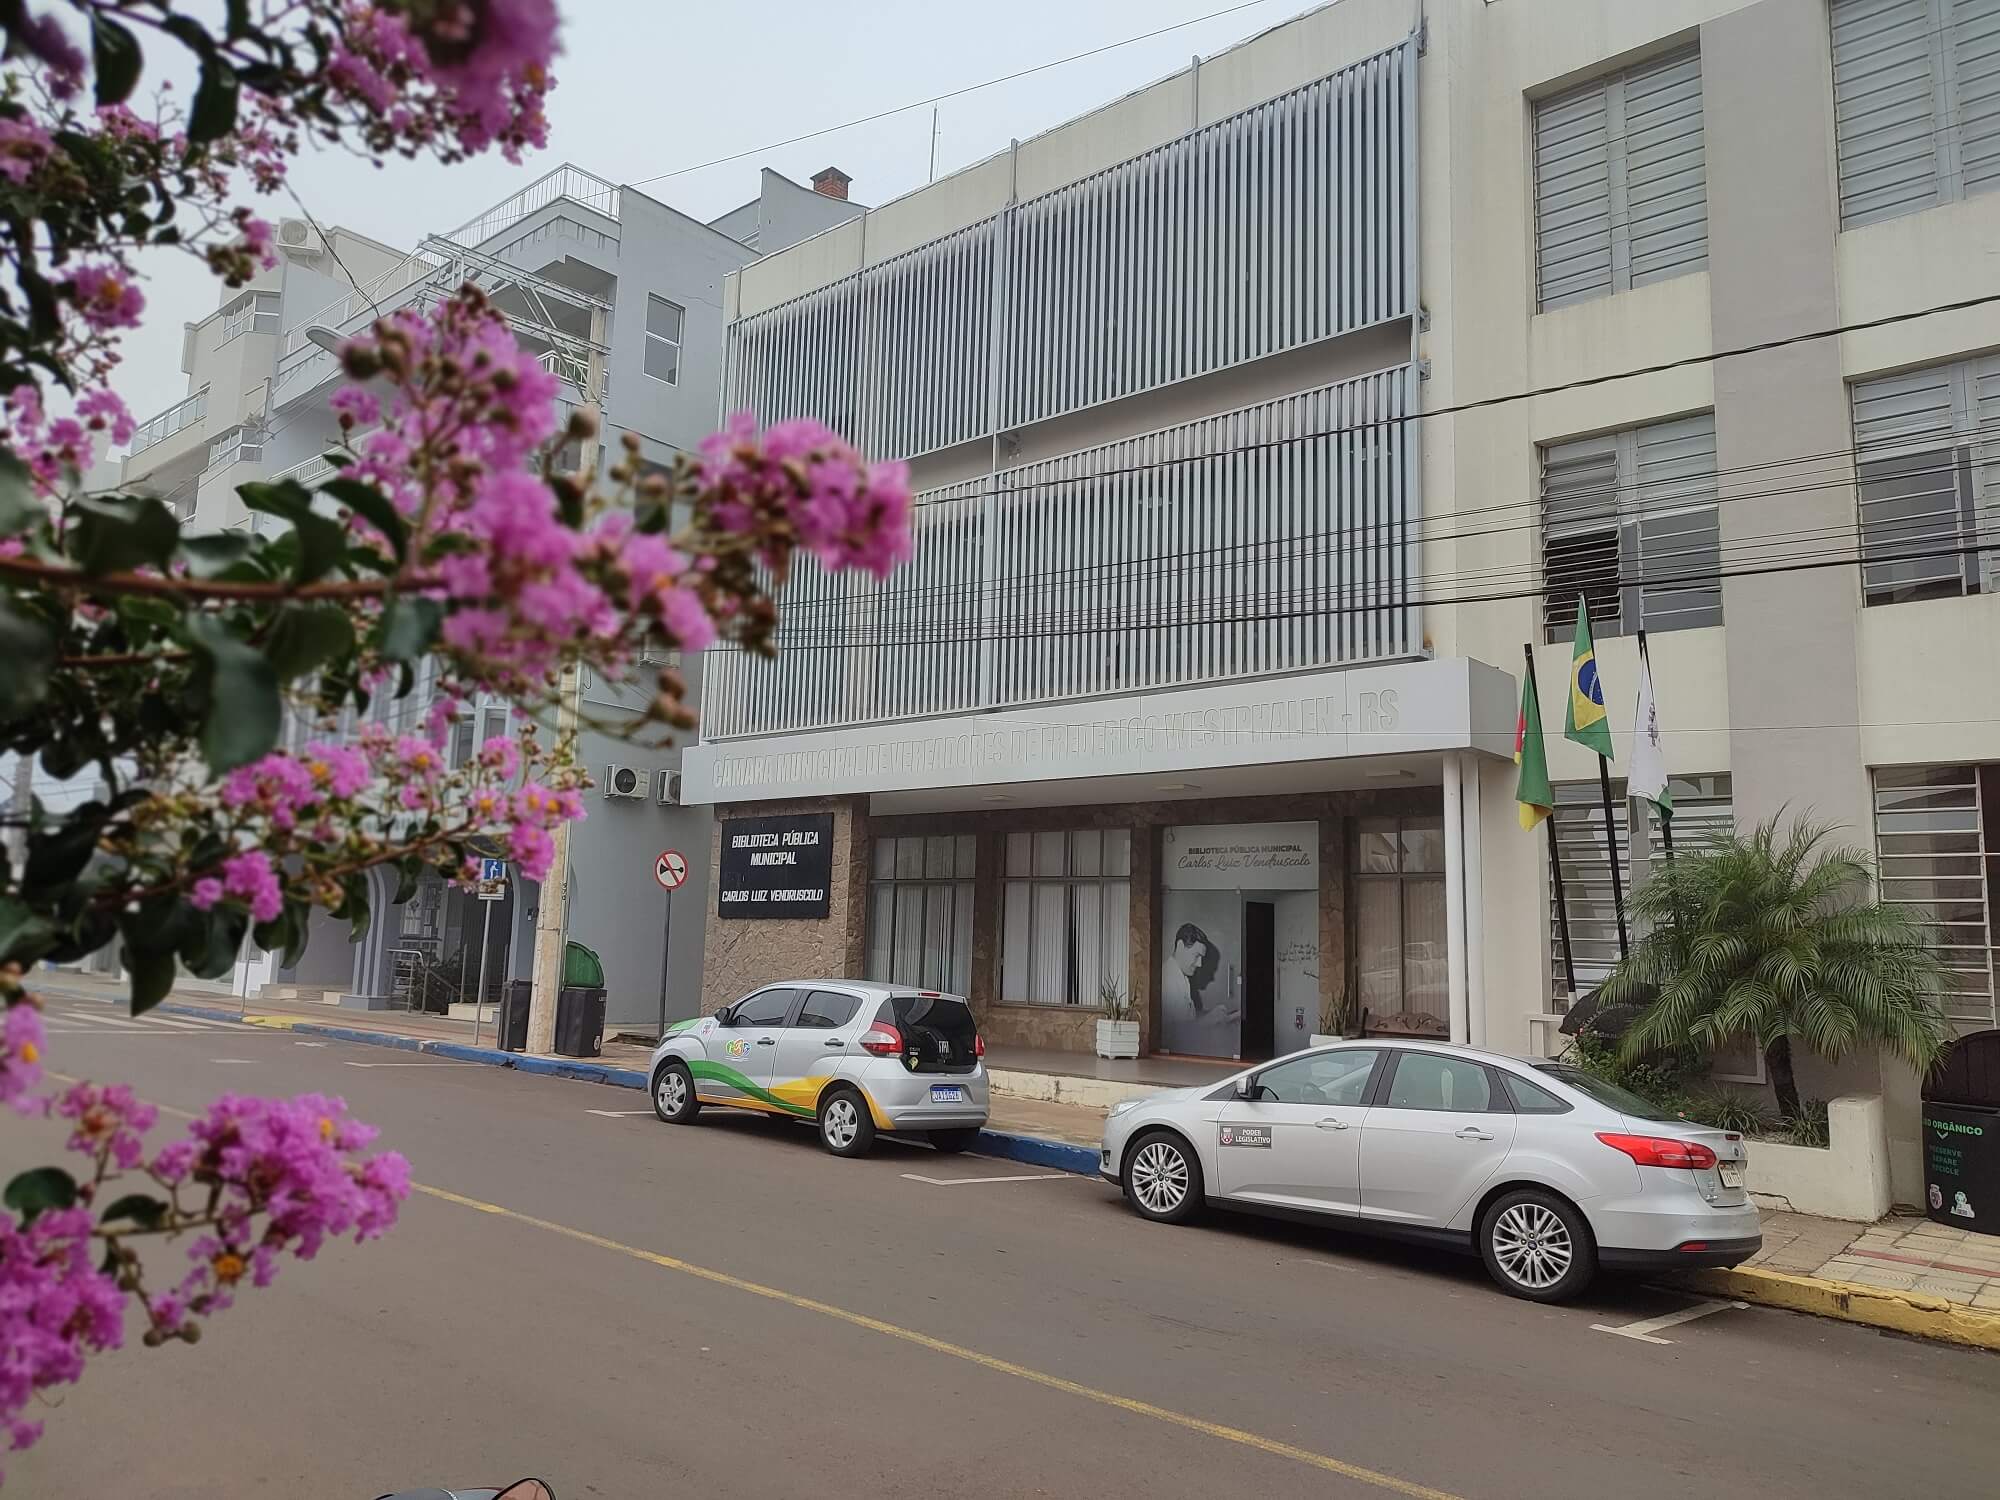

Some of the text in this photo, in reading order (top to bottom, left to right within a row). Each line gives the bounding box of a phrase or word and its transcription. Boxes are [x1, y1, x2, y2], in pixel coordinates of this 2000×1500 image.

[776, 746, 863, 784] MUNICIPAL
[866, 743, 888, 776] DE
[890, 732, 1004, 775] VEREADORES
[1011, 729, 1038, 764] DE
[1041, 715, 1157, 761] FREDERICO
[1164, 696, 1335, 751] WESTPHALEN
[1359, 689, 1399, 733] RS
[731, 829, 819, 849] BIBLIOTECA PÚBLICA
[1188, 847, 1228, 855] BIBLIOTECA
[1261, 845, 1302, 854] MUNICIPAL
[750, 851, 797, 866] MUNICIPAL
[1177, 855, 1214, 868] Carlos
[721, 889, 823, 902] CARLOS LUIZ VENDRUSCOLO
[1242, 1129, 1262, 1137] PODER
[1932, 1120, 1983, 1136] ORGÂNICO
[1235, 1135, 1271, 1144] LEGISLATIVO
